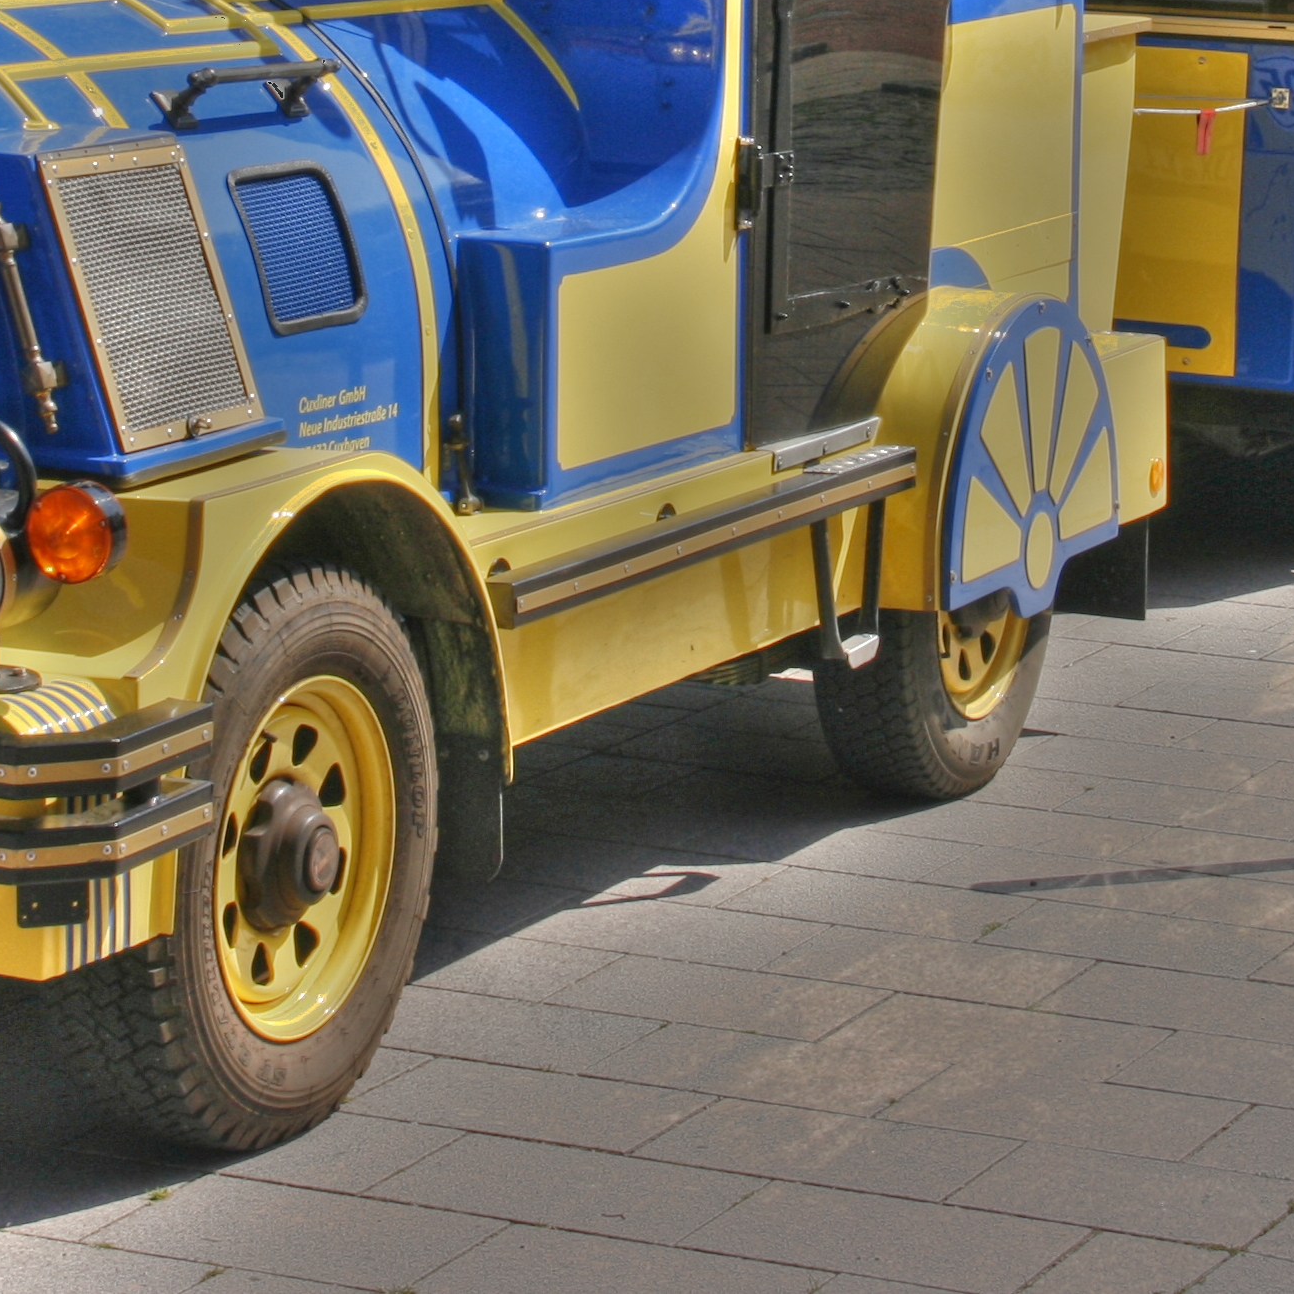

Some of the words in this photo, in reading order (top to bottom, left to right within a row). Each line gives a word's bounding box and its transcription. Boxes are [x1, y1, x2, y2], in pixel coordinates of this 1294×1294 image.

[298, 393, 337, 414] Cuxliner
[339, 385, 367, 406] GmbH
[298, 421, 323, 438] Neue
[323, 406, 387, 432] Industriestraße
[388, 403, 399, 418] 14
